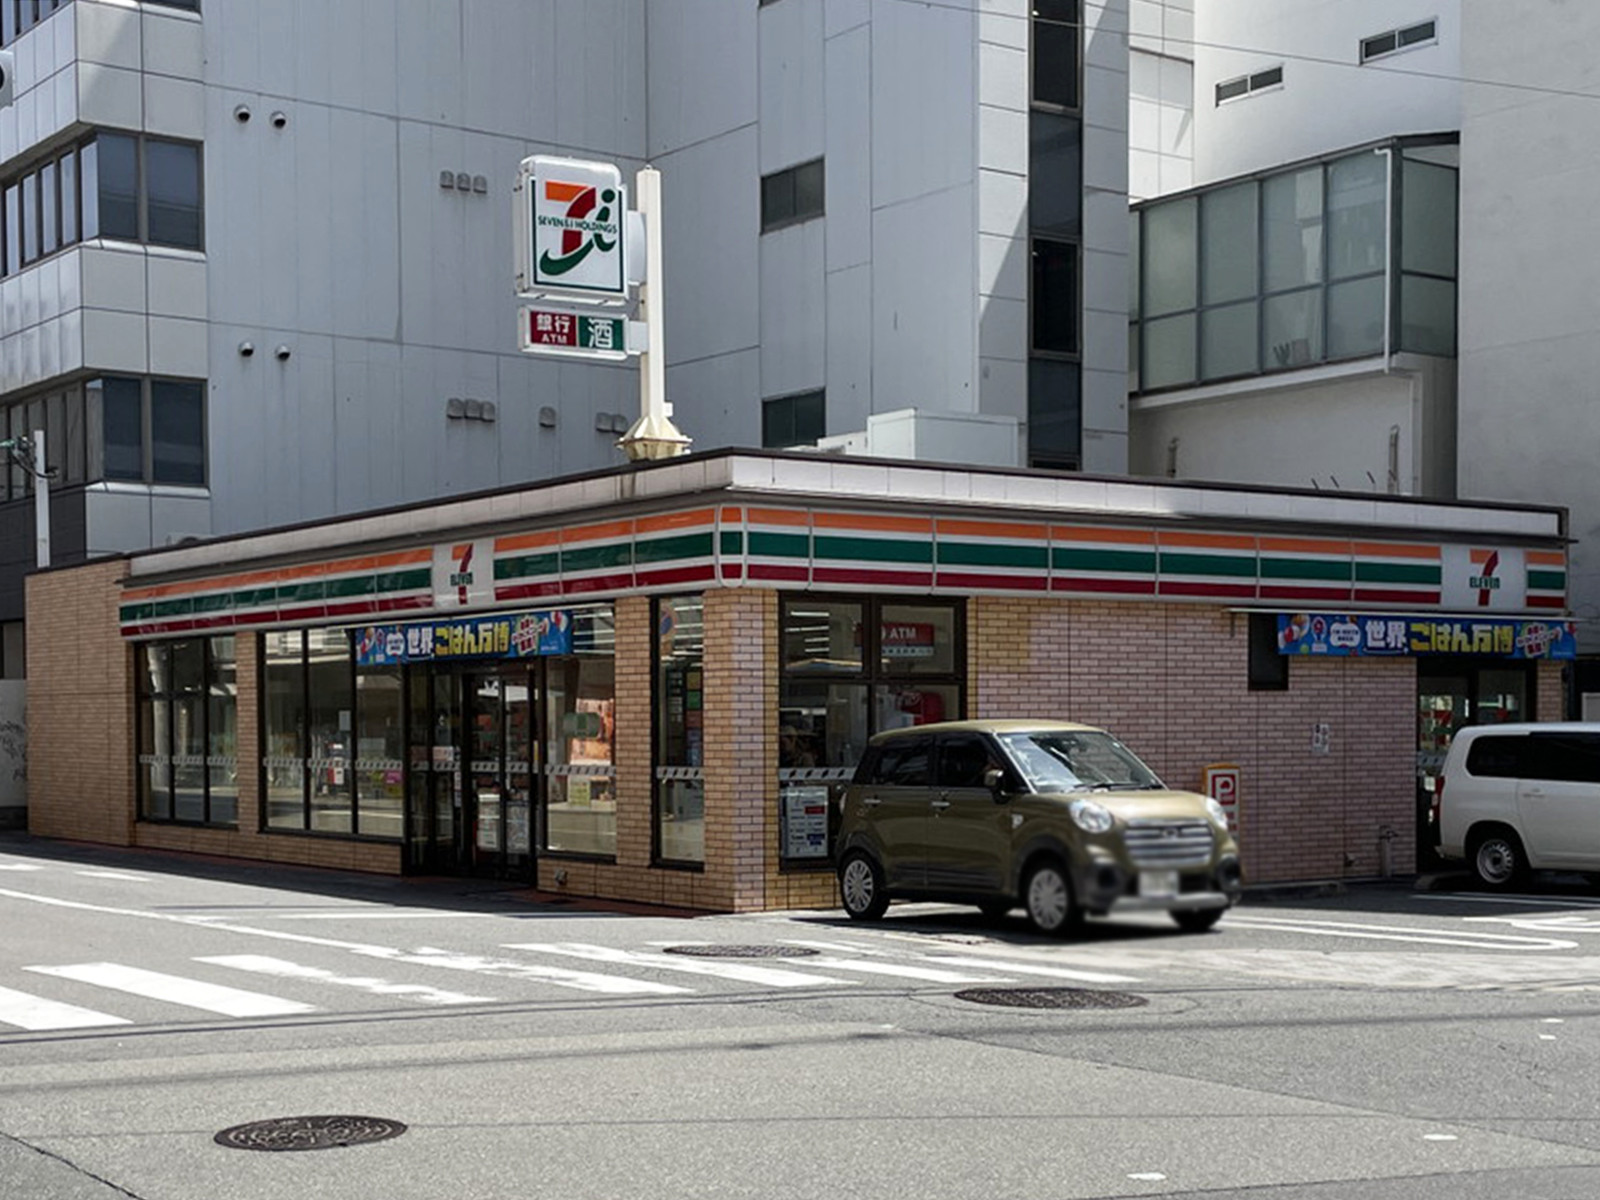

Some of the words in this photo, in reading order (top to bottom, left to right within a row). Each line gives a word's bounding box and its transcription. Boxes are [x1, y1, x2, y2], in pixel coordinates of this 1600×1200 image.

[575, 220, 618, 235] HOLDINGS
[536, 313, 570, 334] 銀行
[541, 333, 568, 344] ATM
[588, 317, 614, 349] 酒
[889, 627, 916, 639] ATM
[1214, 775, 1234, 802] P
